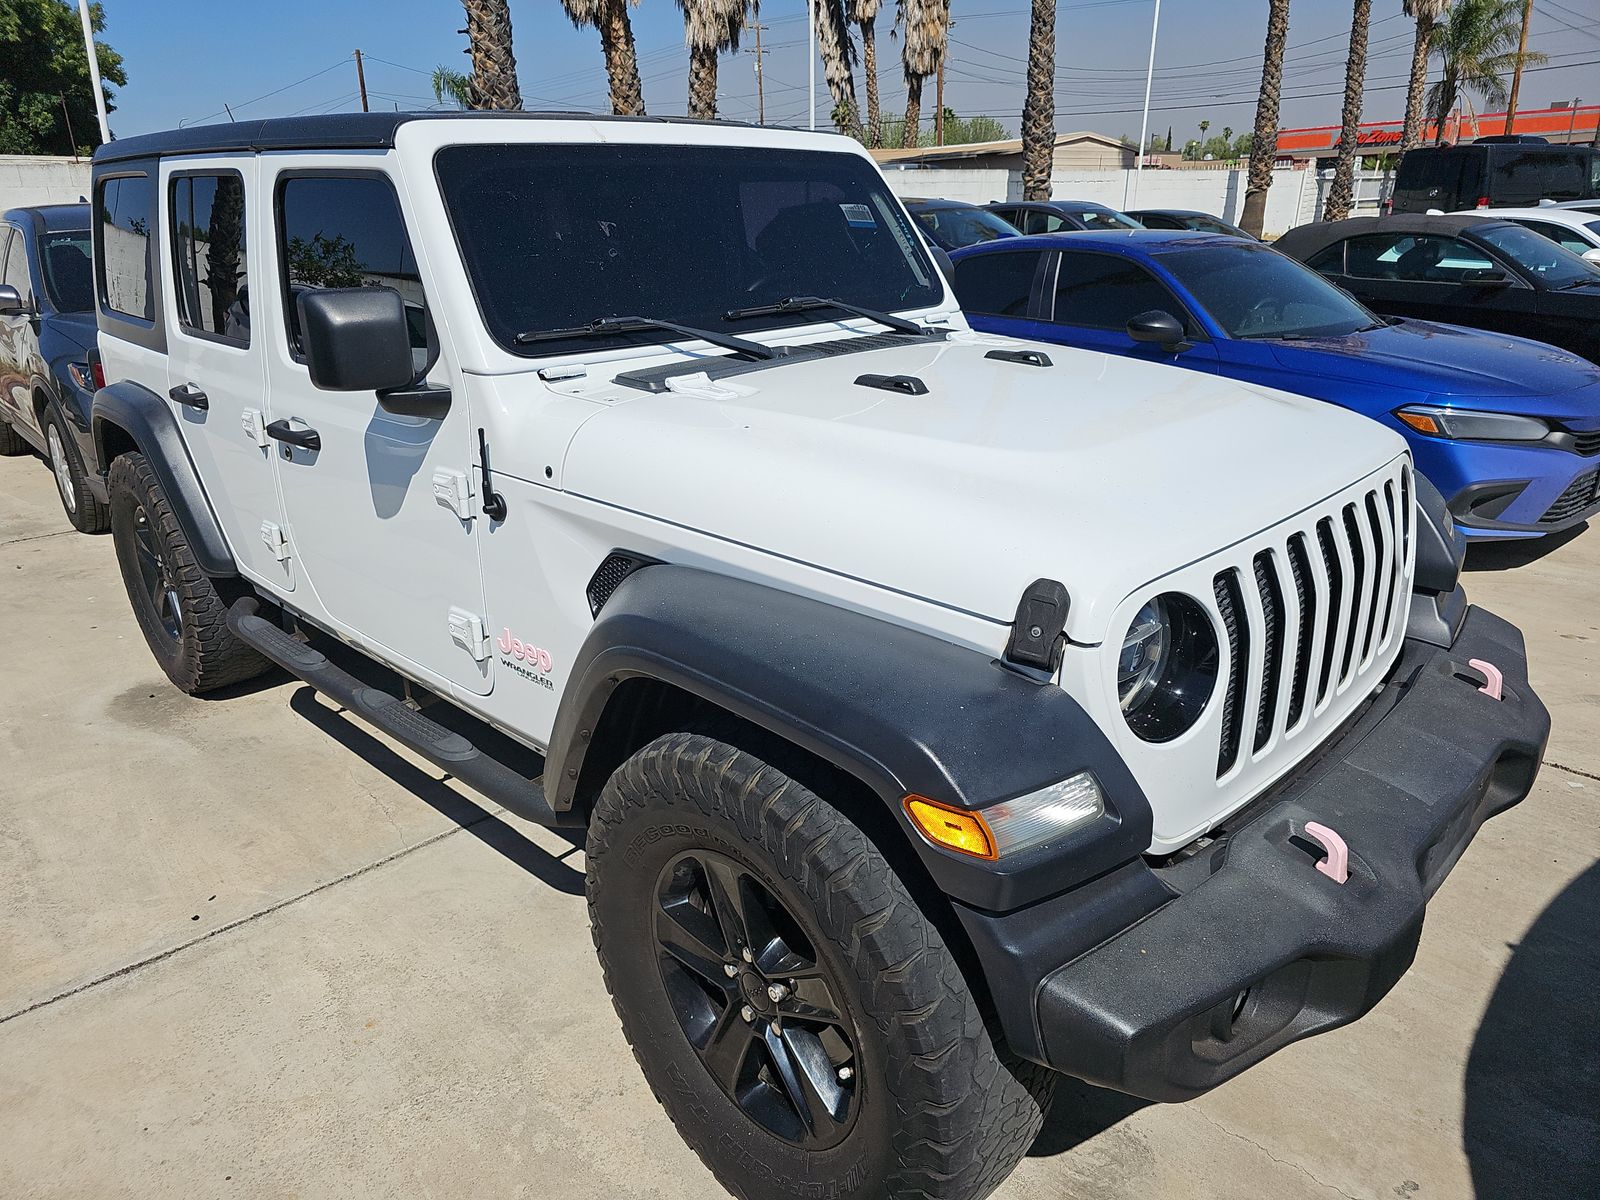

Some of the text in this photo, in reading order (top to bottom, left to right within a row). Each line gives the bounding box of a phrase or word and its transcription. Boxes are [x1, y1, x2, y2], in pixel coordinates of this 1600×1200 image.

[1335, 130, 1404, 145] oZone
[497, 627, 552, 675] Jeep
[500, 657, 554, 687] WRANGLER
